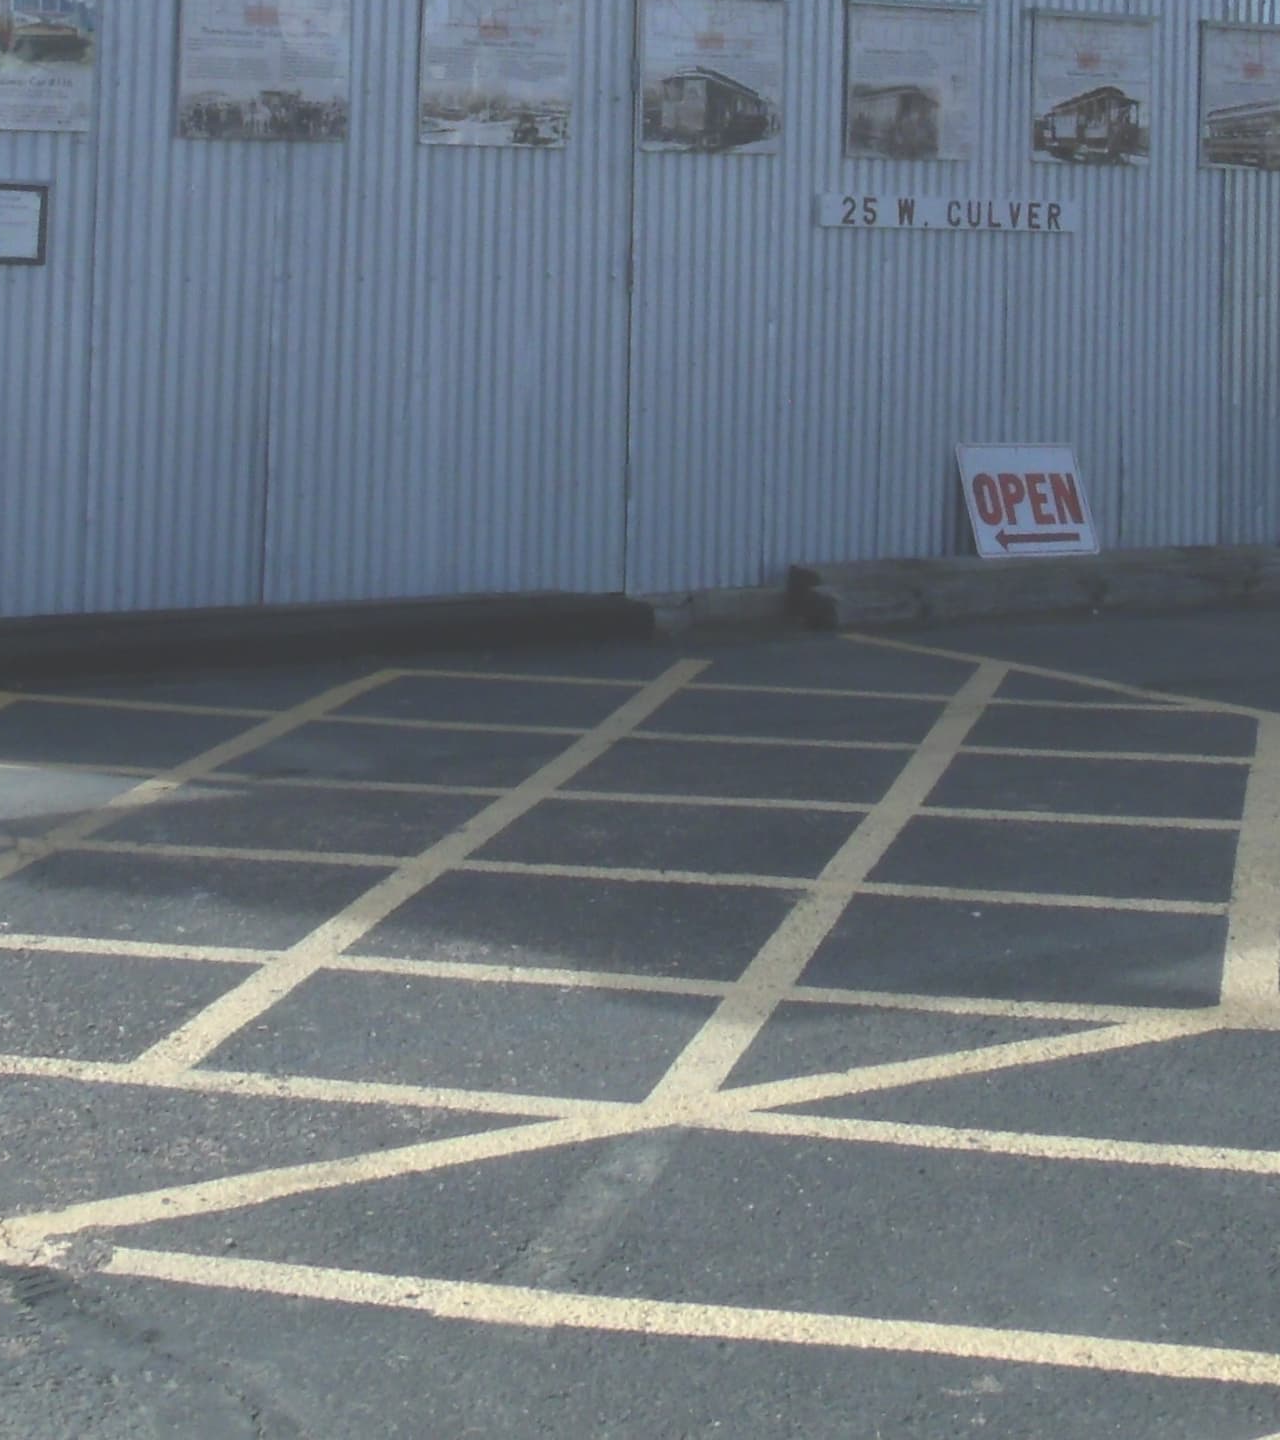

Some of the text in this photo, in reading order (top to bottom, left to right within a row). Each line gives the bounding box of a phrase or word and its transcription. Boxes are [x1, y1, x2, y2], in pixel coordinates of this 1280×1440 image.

[841, 196, 1062, 230] 25 W. CULVER
[972, 471, 1085, 526] OPEN
